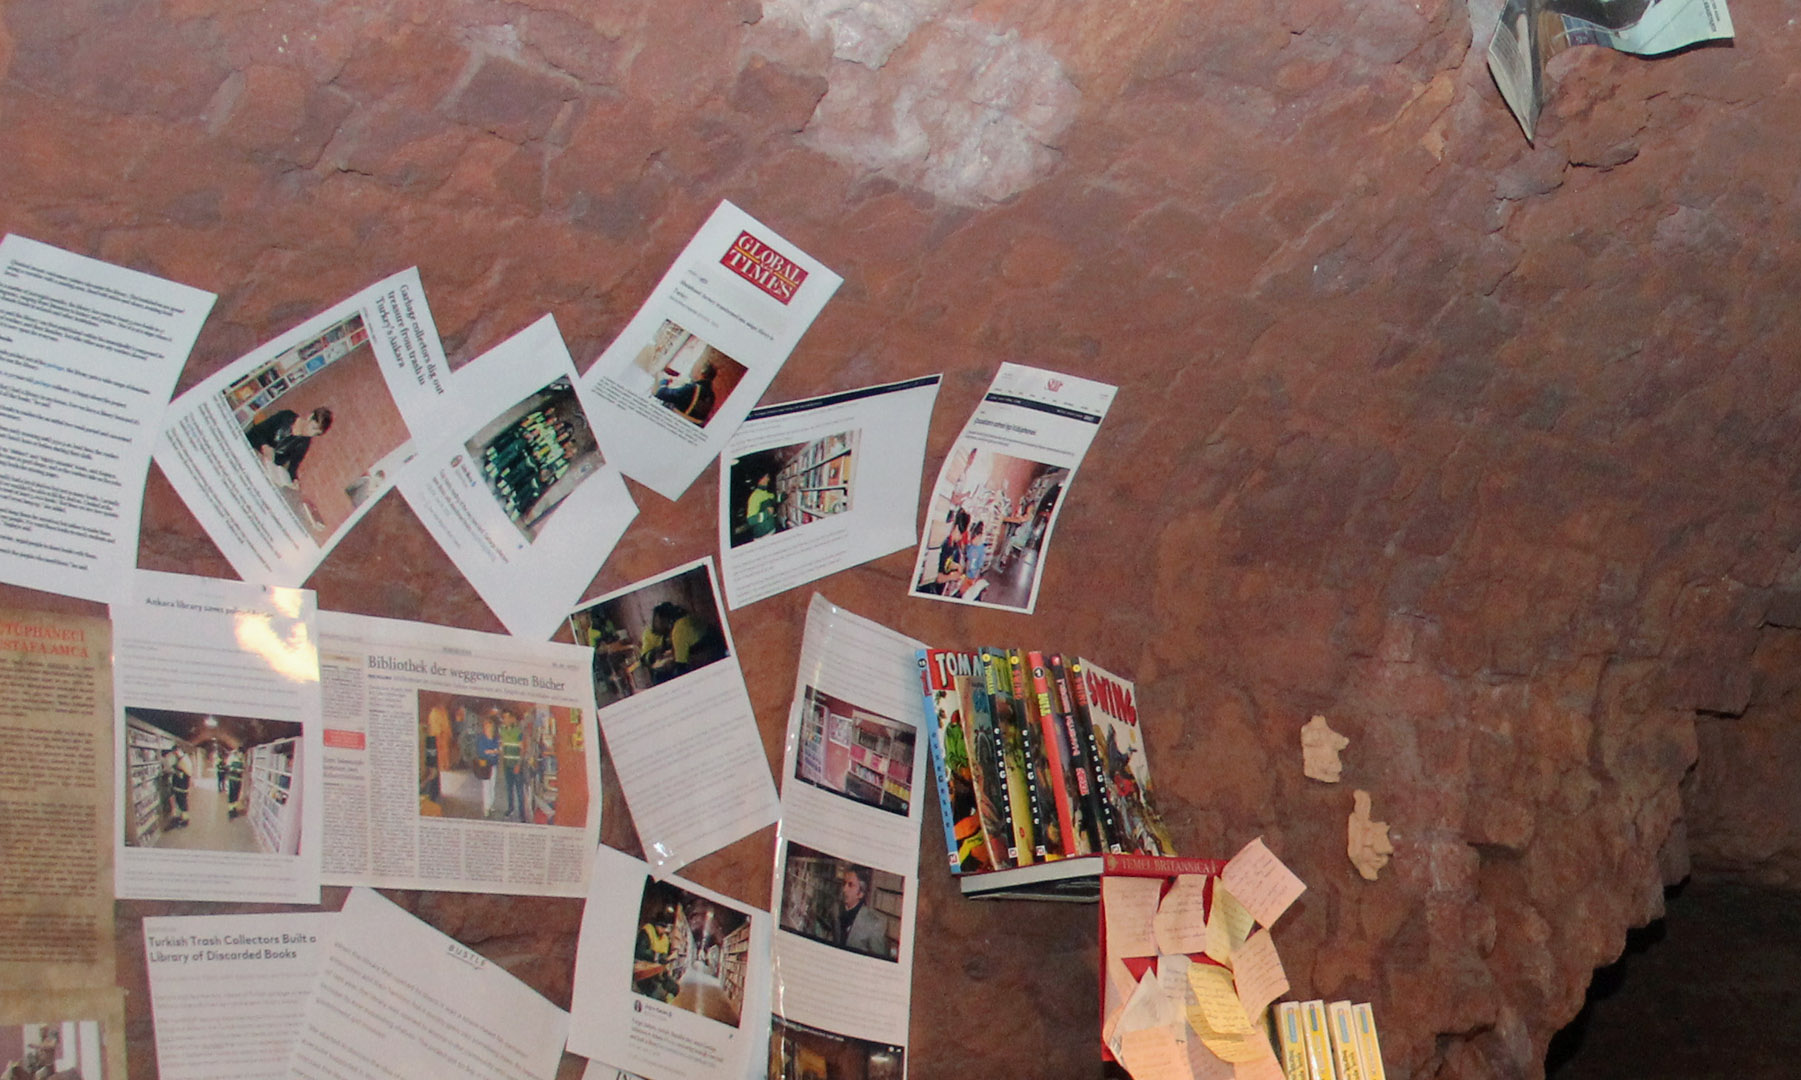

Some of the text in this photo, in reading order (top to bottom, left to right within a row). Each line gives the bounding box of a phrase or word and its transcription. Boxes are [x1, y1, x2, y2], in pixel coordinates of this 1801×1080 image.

[724, 248, 795, 300] TIMES
[734, 232, 806, 285] GLOBAL
[372, 295, 408, 368] Turkey's Ankara
[386, 290, 427, 385] treasure from trash in
[396, 283, 444, 396] Garbage collectors dig out
[145, 595, 175, 607] Ankara
[175, 598, 202, 612] library
[203, 604, 225, 614] saves
[366, 652, 566, 692] Bibliothek der weggeworfenen Bücher
[1121, 856, 1211, 873] TEMEL BRITANNICA
[148, 933, 316, 948] Turkish Trash Collectors Built a
[149, 948, 297, 964] Library of Discarded Books
[448, 945, 487, 967] BUSTLE
